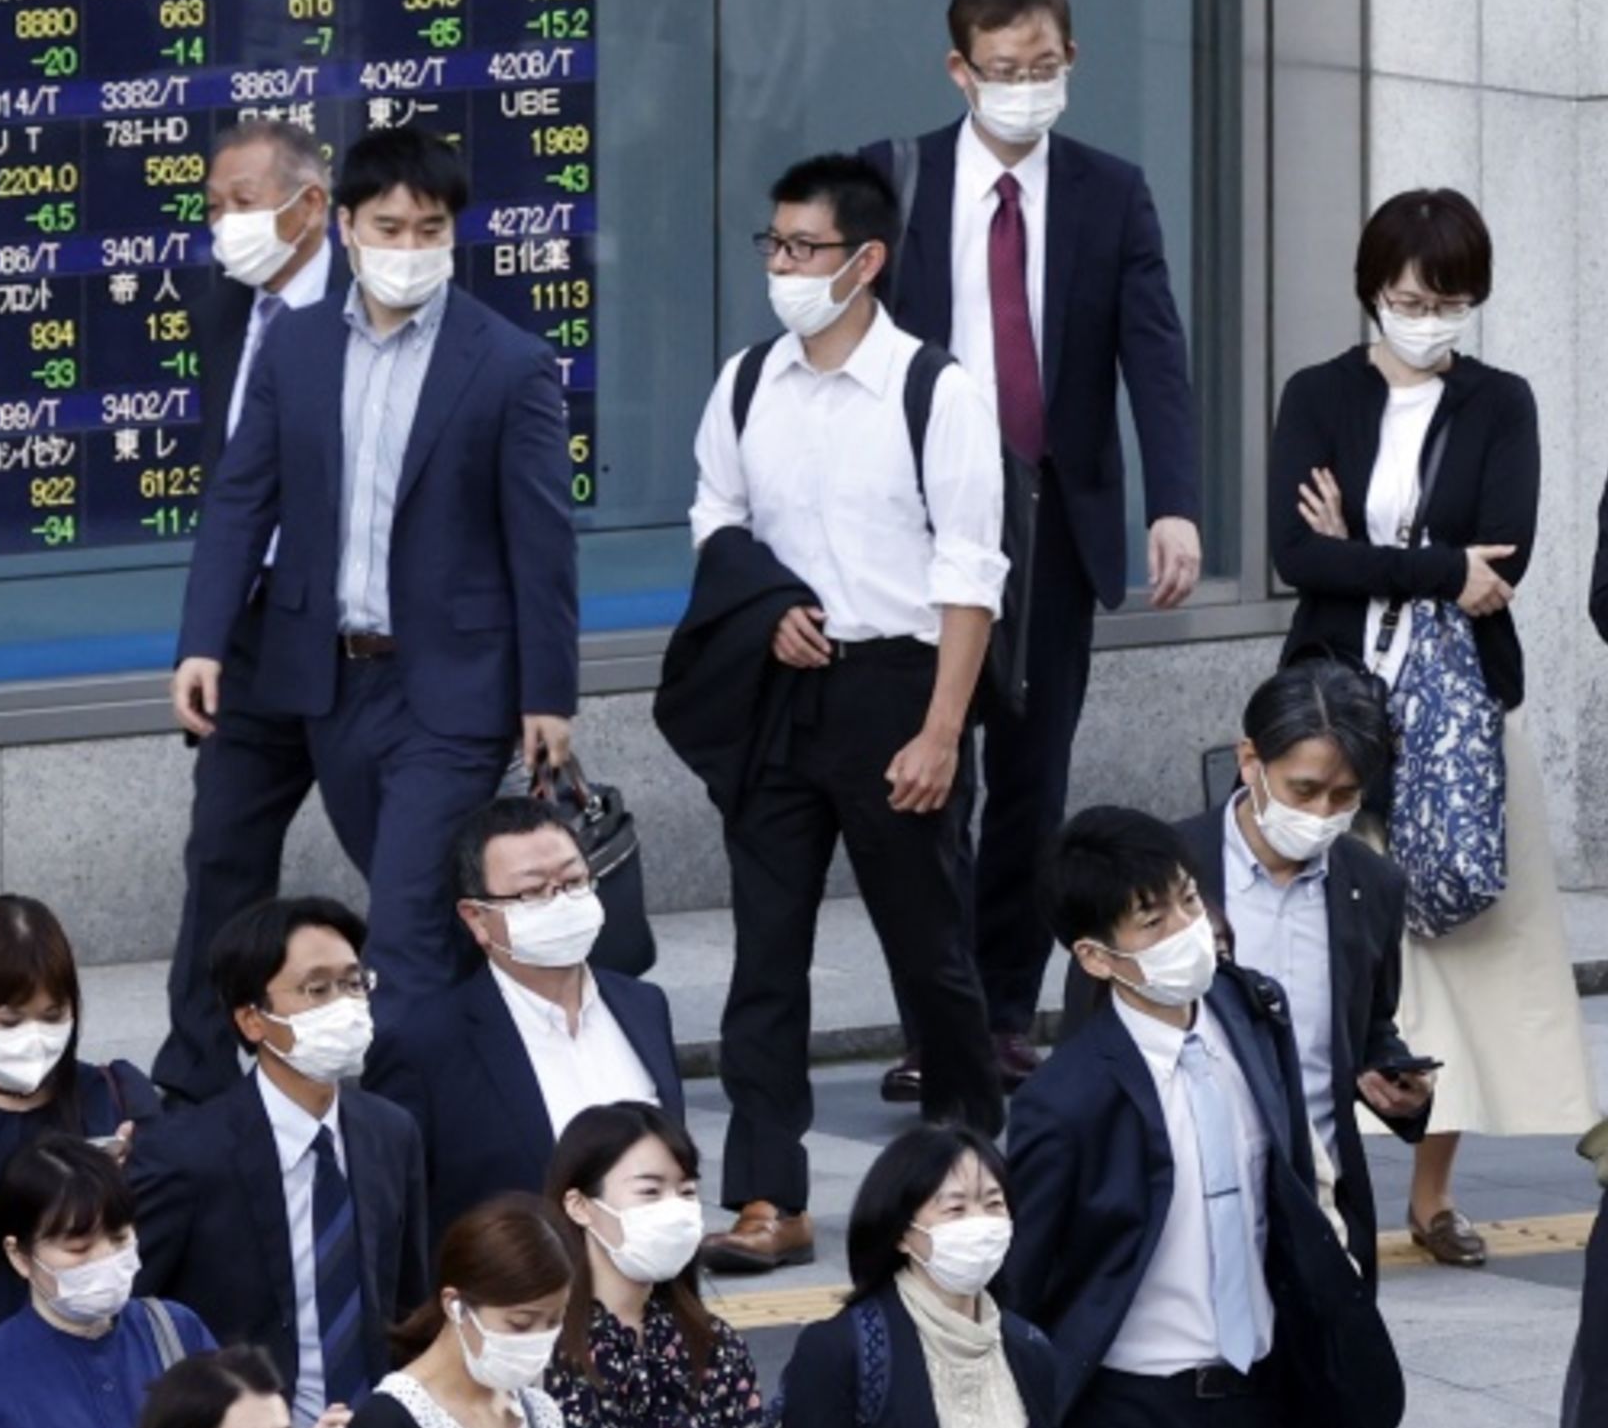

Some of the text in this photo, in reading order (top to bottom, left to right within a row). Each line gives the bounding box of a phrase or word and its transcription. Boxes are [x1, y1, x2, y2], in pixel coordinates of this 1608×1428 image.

[359, 56, 446, 90] 4042/T
[101, 75, 190, 112] 3382/T
[500, 87, 561, 118] UBE
[487, 202, 574, 237] 4272/T
[101, 232, 190, 267] 3401/T
[494, 238, 570, 276] 日化薬
[101, 388, 190, 424] 3402/T
